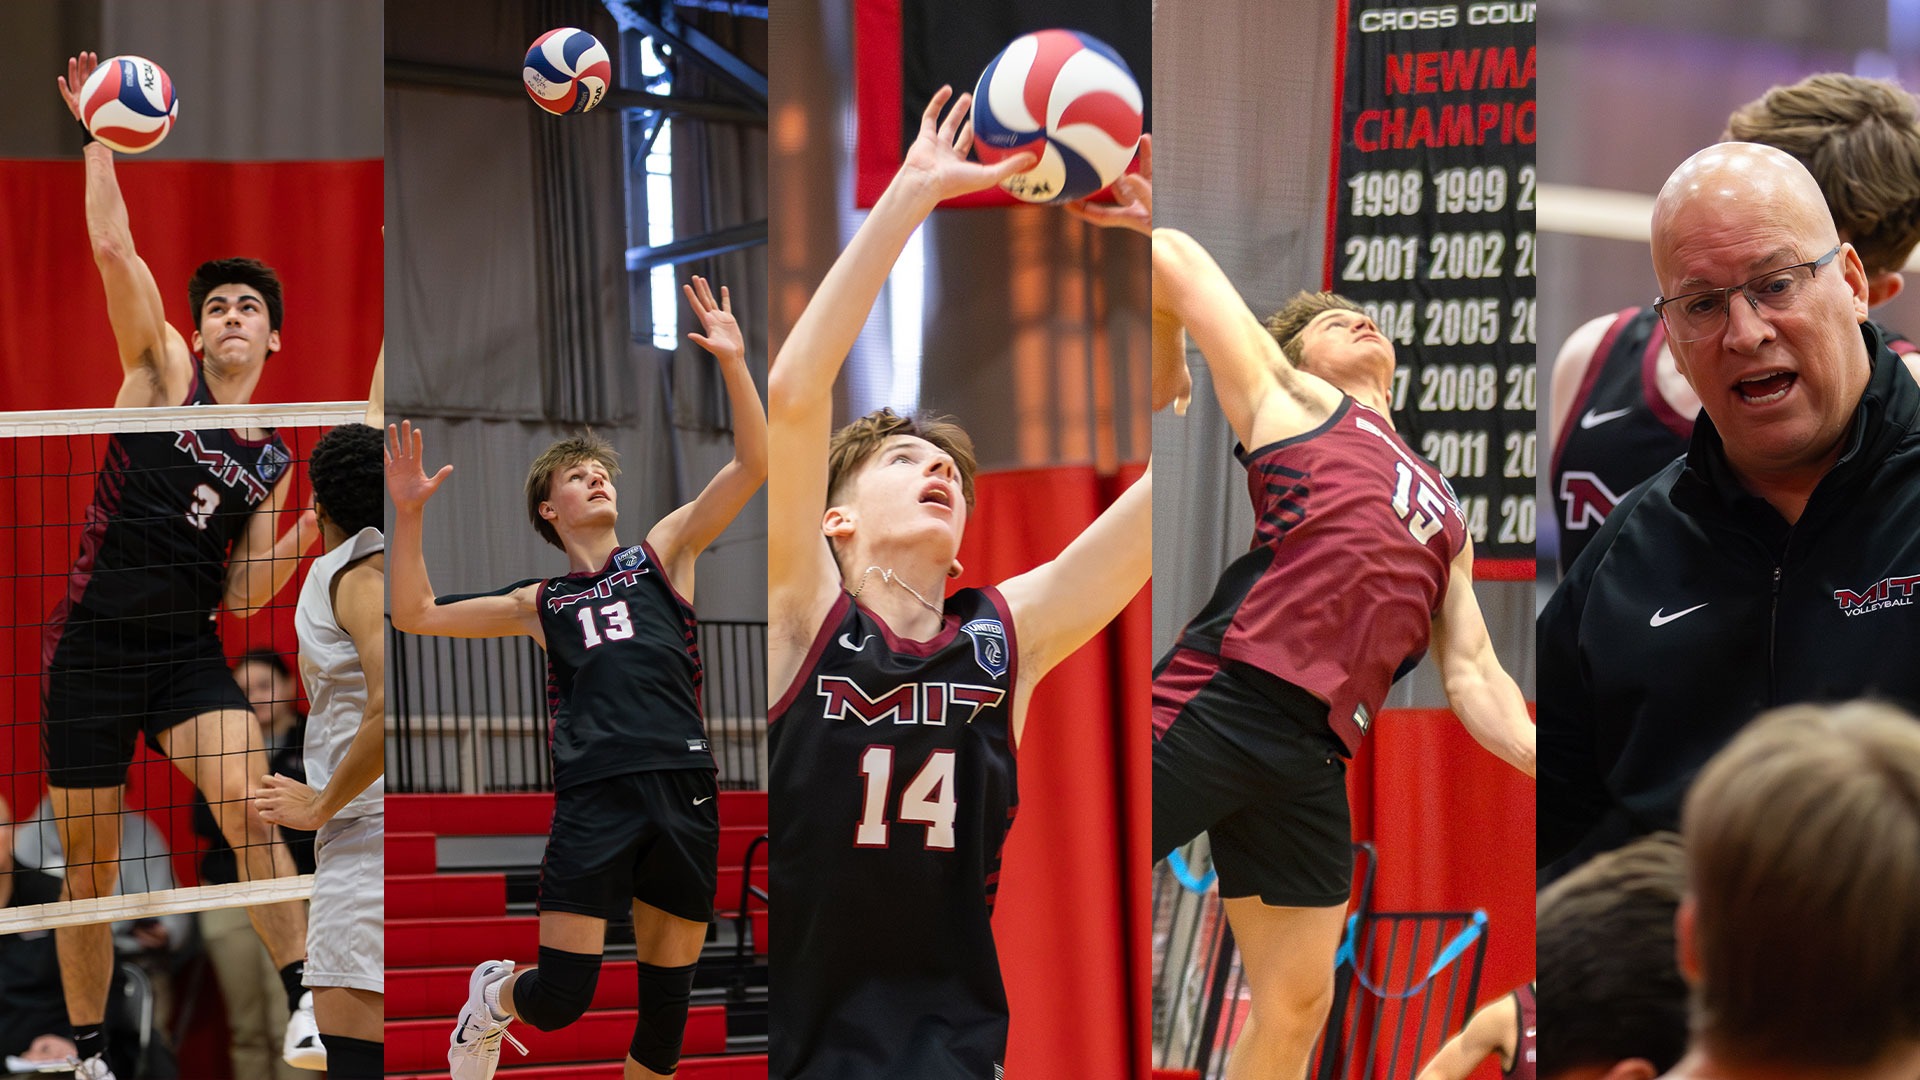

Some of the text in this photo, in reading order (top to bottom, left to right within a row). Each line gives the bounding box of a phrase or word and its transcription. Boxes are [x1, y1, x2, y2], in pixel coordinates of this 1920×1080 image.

[1360, 9, 1458, 32] CROSS
[1354, 101, 1536, 152] CHAMPIO
[1348, 170, 1422, 217] 1998
[1434, 167, 1507, 213] 1999
[1343, 235, 1418, 281] 2001
[1430, 231, 1505, 279] 2002
[1423, 299, 1499, 346] 2005
[1419, 364, 1497, 411] 2008
[174, 430, 269, 505] MIT
[1422, 431, 1487, 478] 2011
[185, 483, 220, 530] 3
[1392, 461, 1446, 545] 15
[1834, 574, 1920, 609] MIT
[1844, 597, 1913, 617] VOLLEYBALL
[577, 600, 635, 650] 13
[967, 623, 1002, 634] UNITED
[816, 675, 1006, 726] MIT
[853, 744, 957, 852] 14
